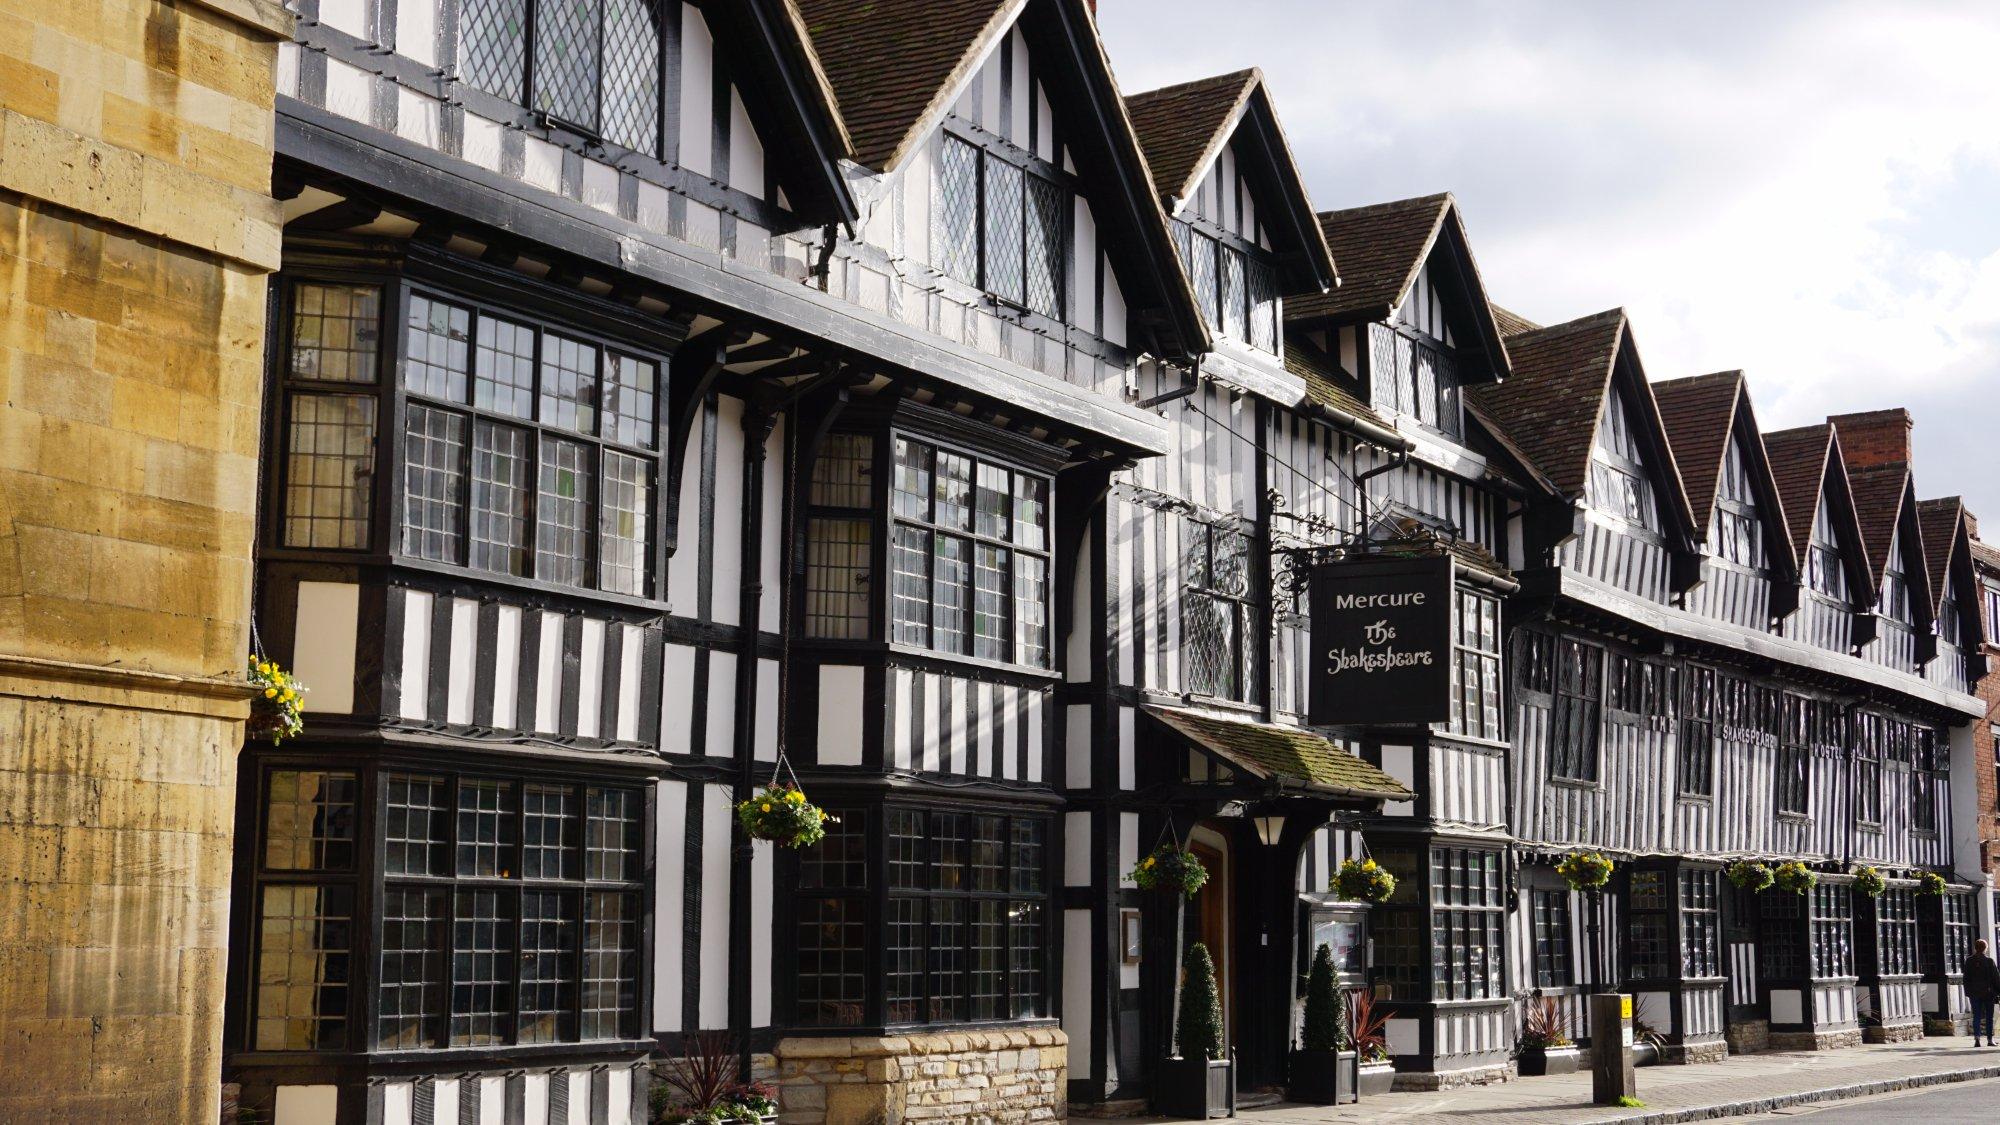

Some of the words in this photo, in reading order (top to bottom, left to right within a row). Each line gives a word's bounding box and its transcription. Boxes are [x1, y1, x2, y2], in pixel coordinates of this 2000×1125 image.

[1336, 592, 1425, 610] Mercure
[1364, 619, 1397, 645] The
[1327, 645, 1433, 675] Shakespeare
[1651, 715, 1674, 734] THE
[1722, 724, 1775, 749] SHAKESPEARE
